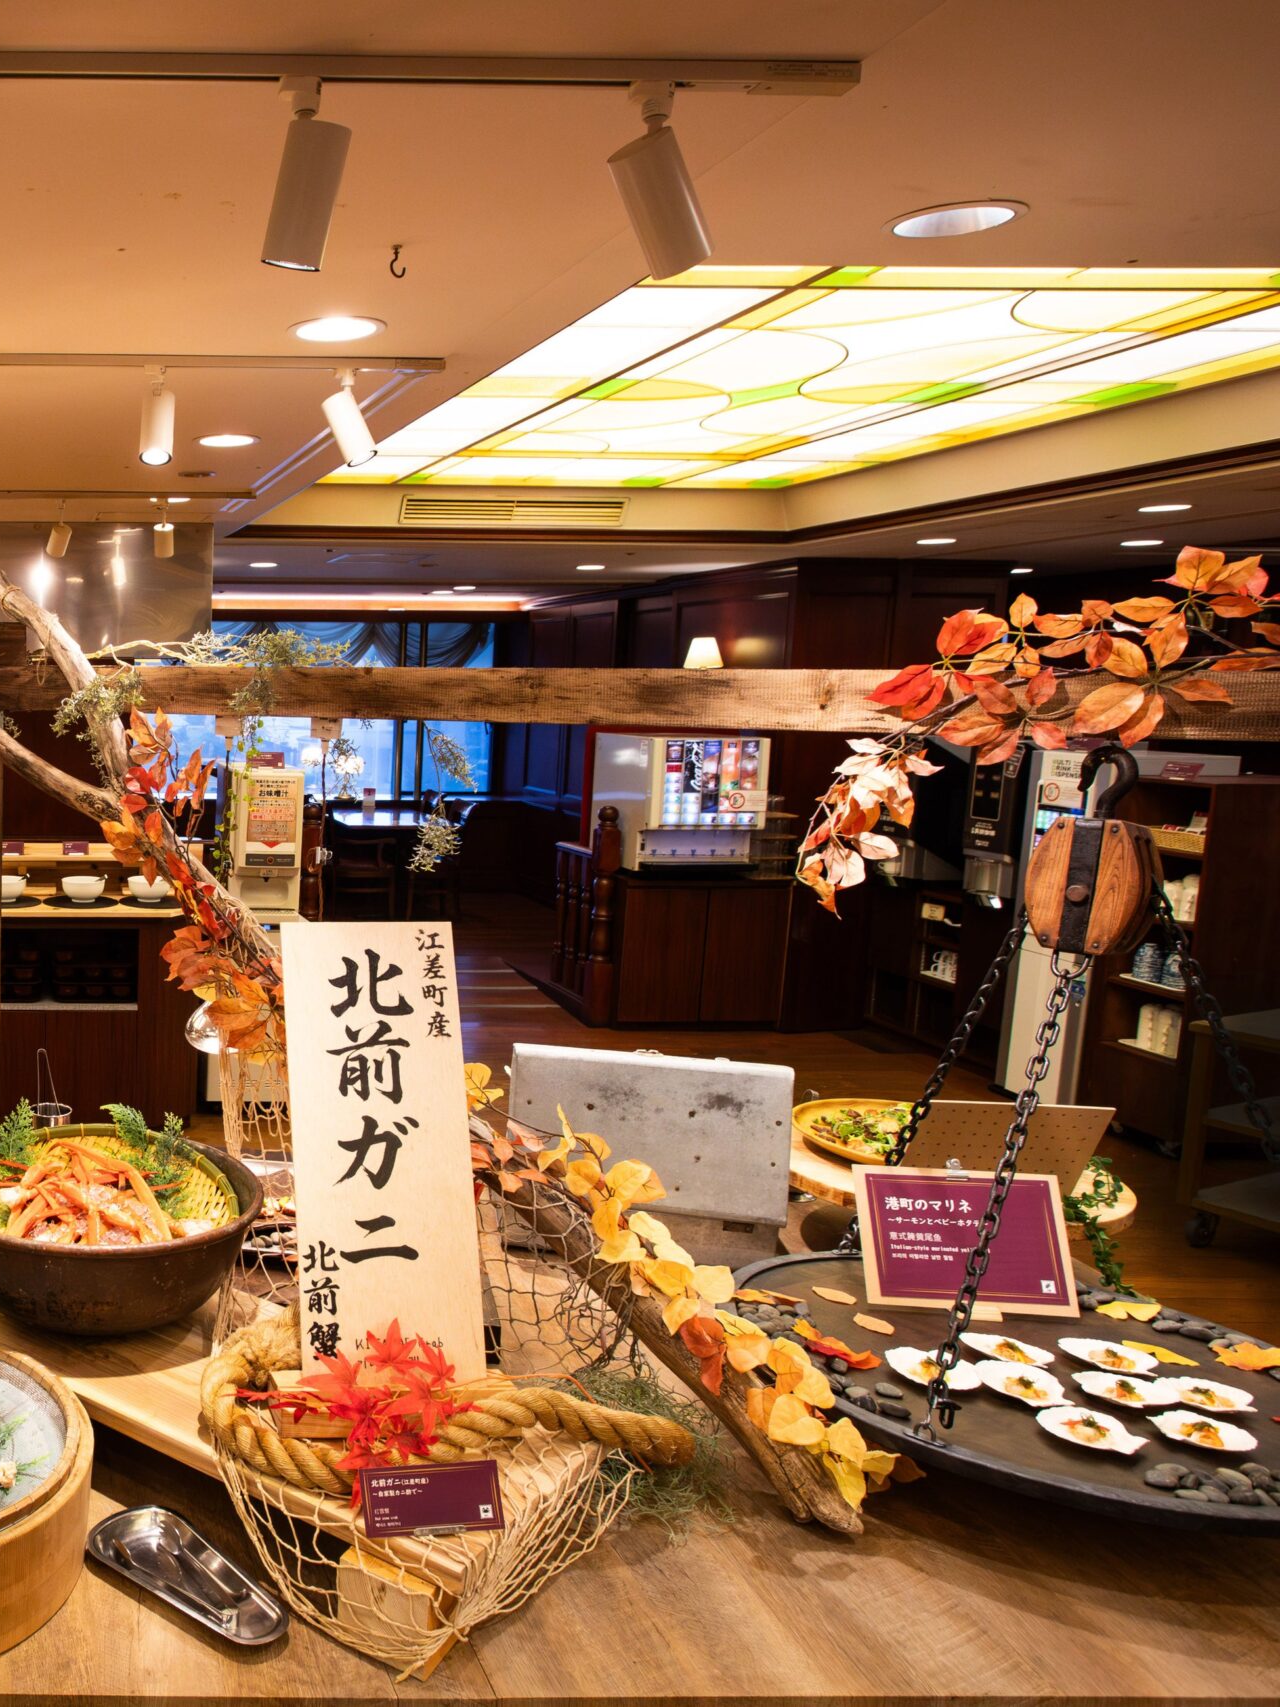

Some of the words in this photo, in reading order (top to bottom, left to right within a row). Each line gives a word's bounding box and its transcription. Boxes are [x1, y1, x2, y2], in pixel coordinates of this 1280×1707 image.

[415, 928, 452, 1039] 江差町産
[326, 948, 419, 1266] 北前ガニ
[884, 1196, 973, 1214] 港町のマリネ
[303, 1240, 342, 1360] 北前蟹
